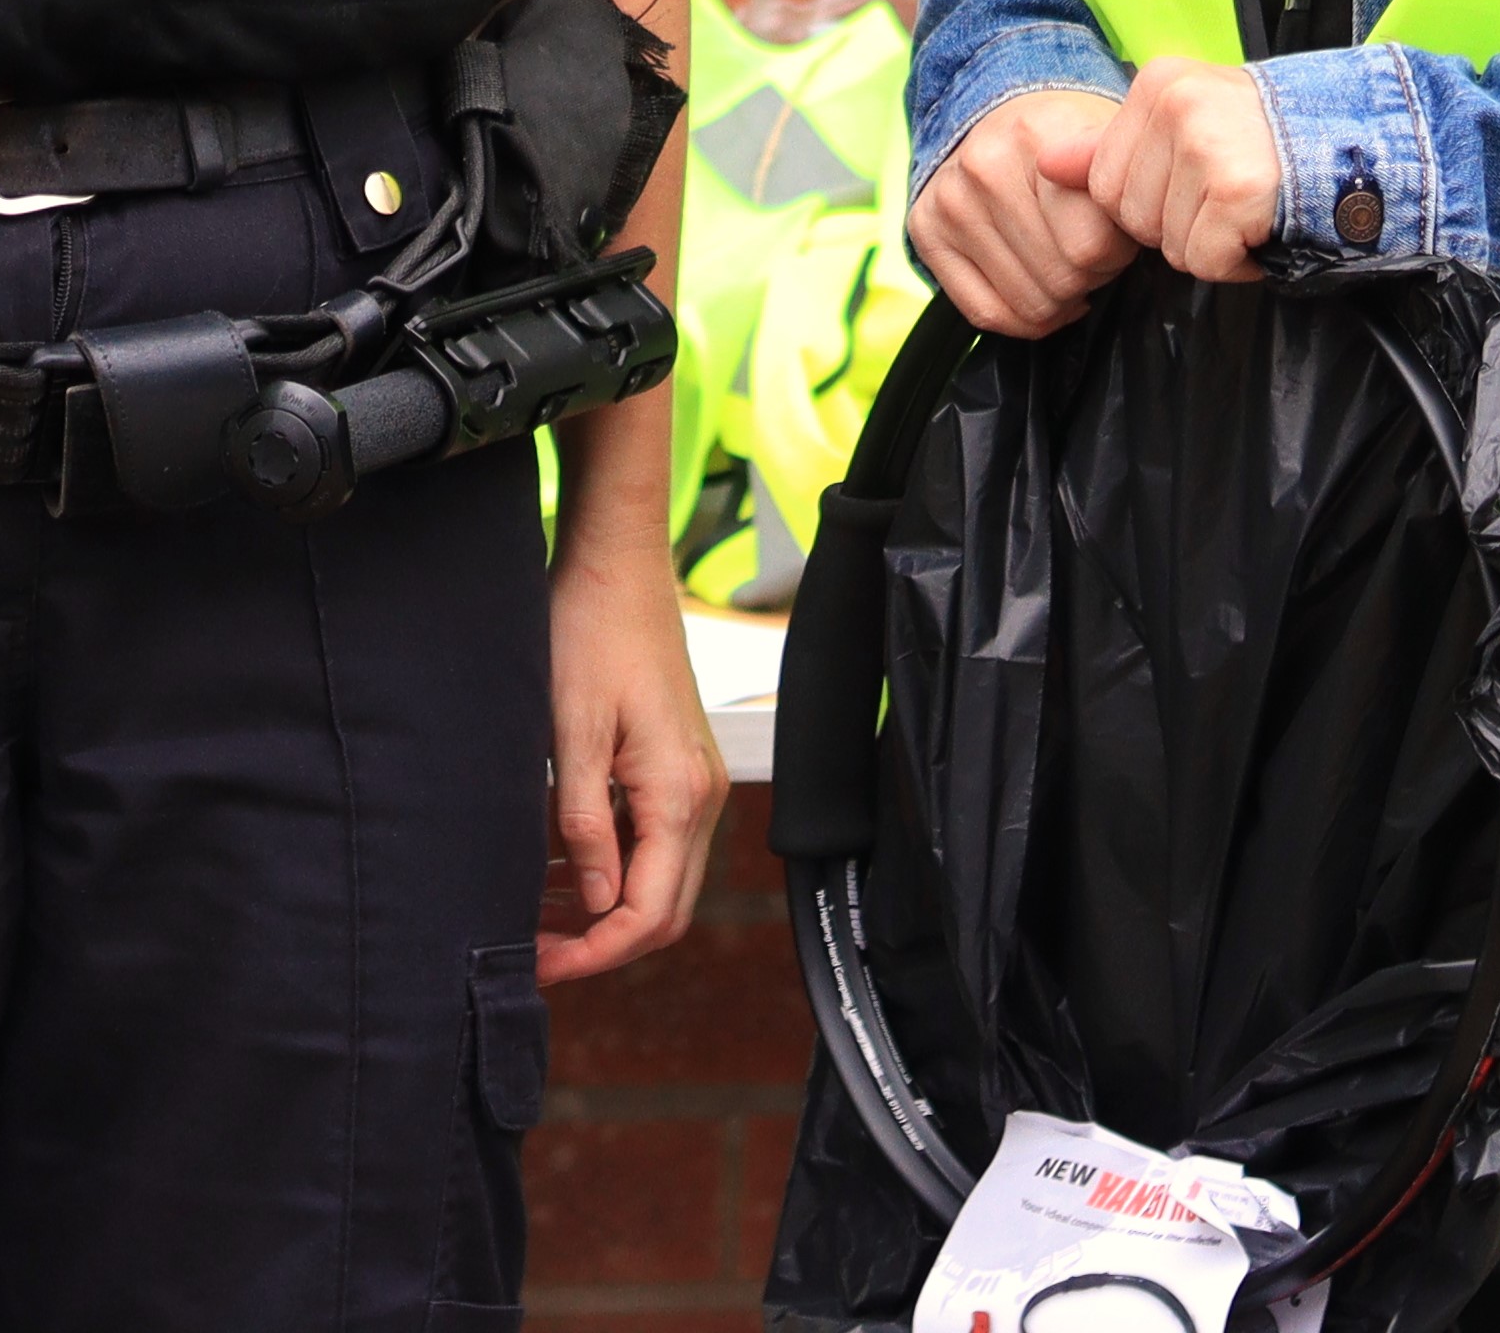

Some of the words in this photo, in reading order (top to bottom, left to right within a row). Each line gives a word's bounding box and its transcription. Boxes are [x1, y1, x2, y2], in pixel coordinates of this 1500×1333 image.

[815, 888, 826, 907] The
[827, 942, 843, 968] Hand
[1035, 1157, 1098, 1188] NEW
